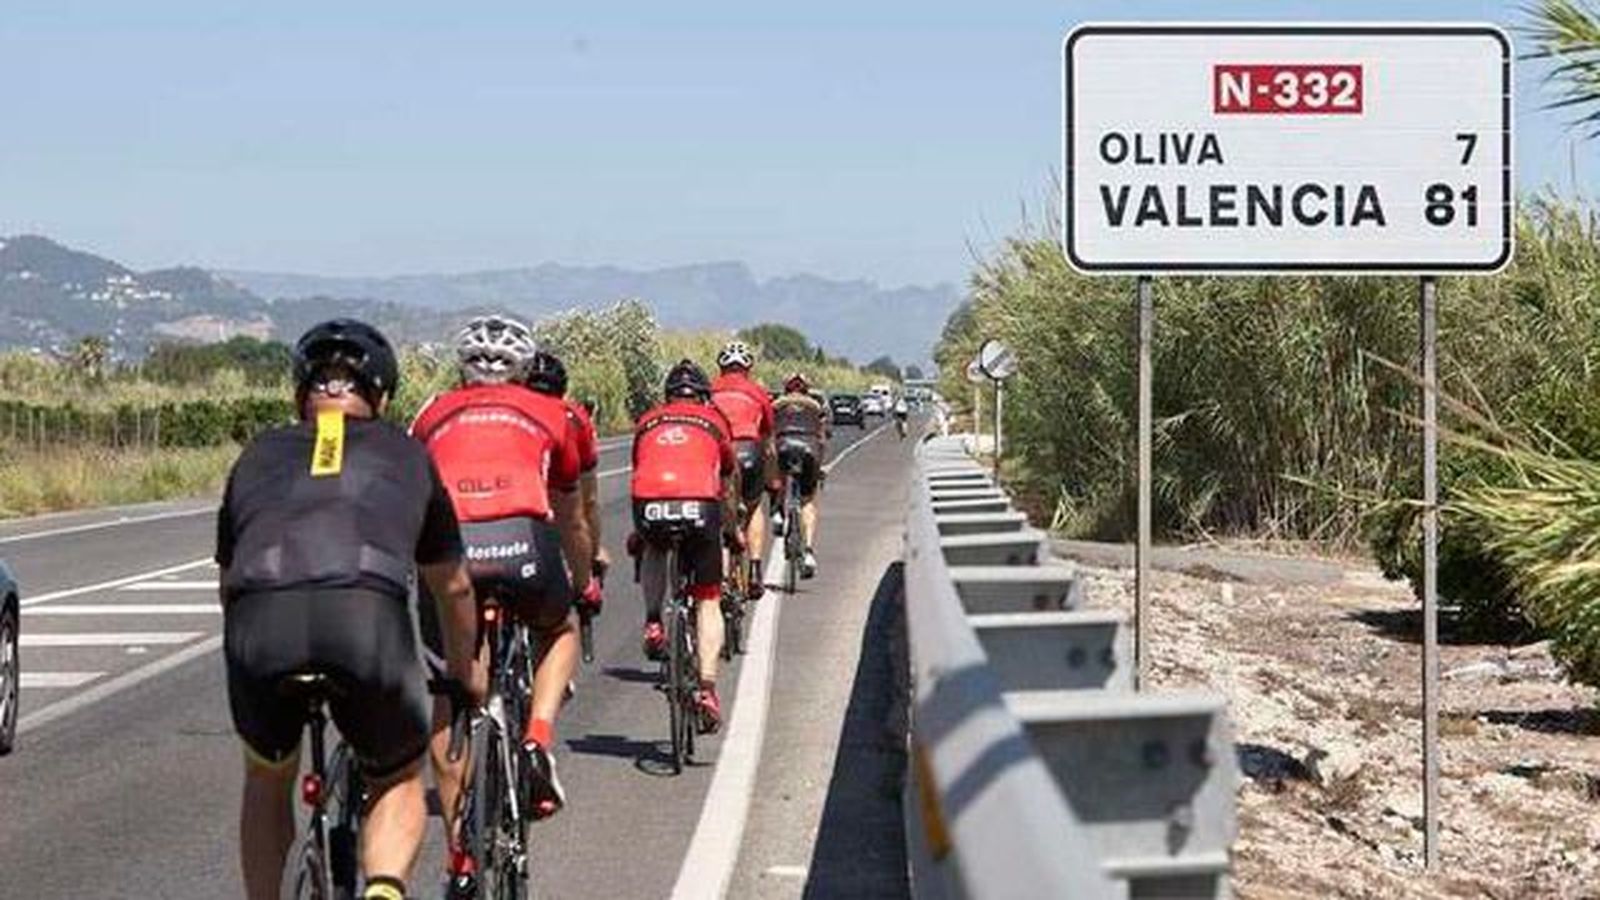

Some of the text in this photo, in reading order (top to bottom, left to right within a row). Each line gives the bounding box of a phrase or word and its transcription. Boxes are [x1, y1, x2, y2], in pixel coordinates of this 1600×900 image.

[1219, 72, 1358, 108] N-332
[1099, 132, 1479, 166] OLIVA 7
[1099, 183, 1479, 228] VALENCIA 81
